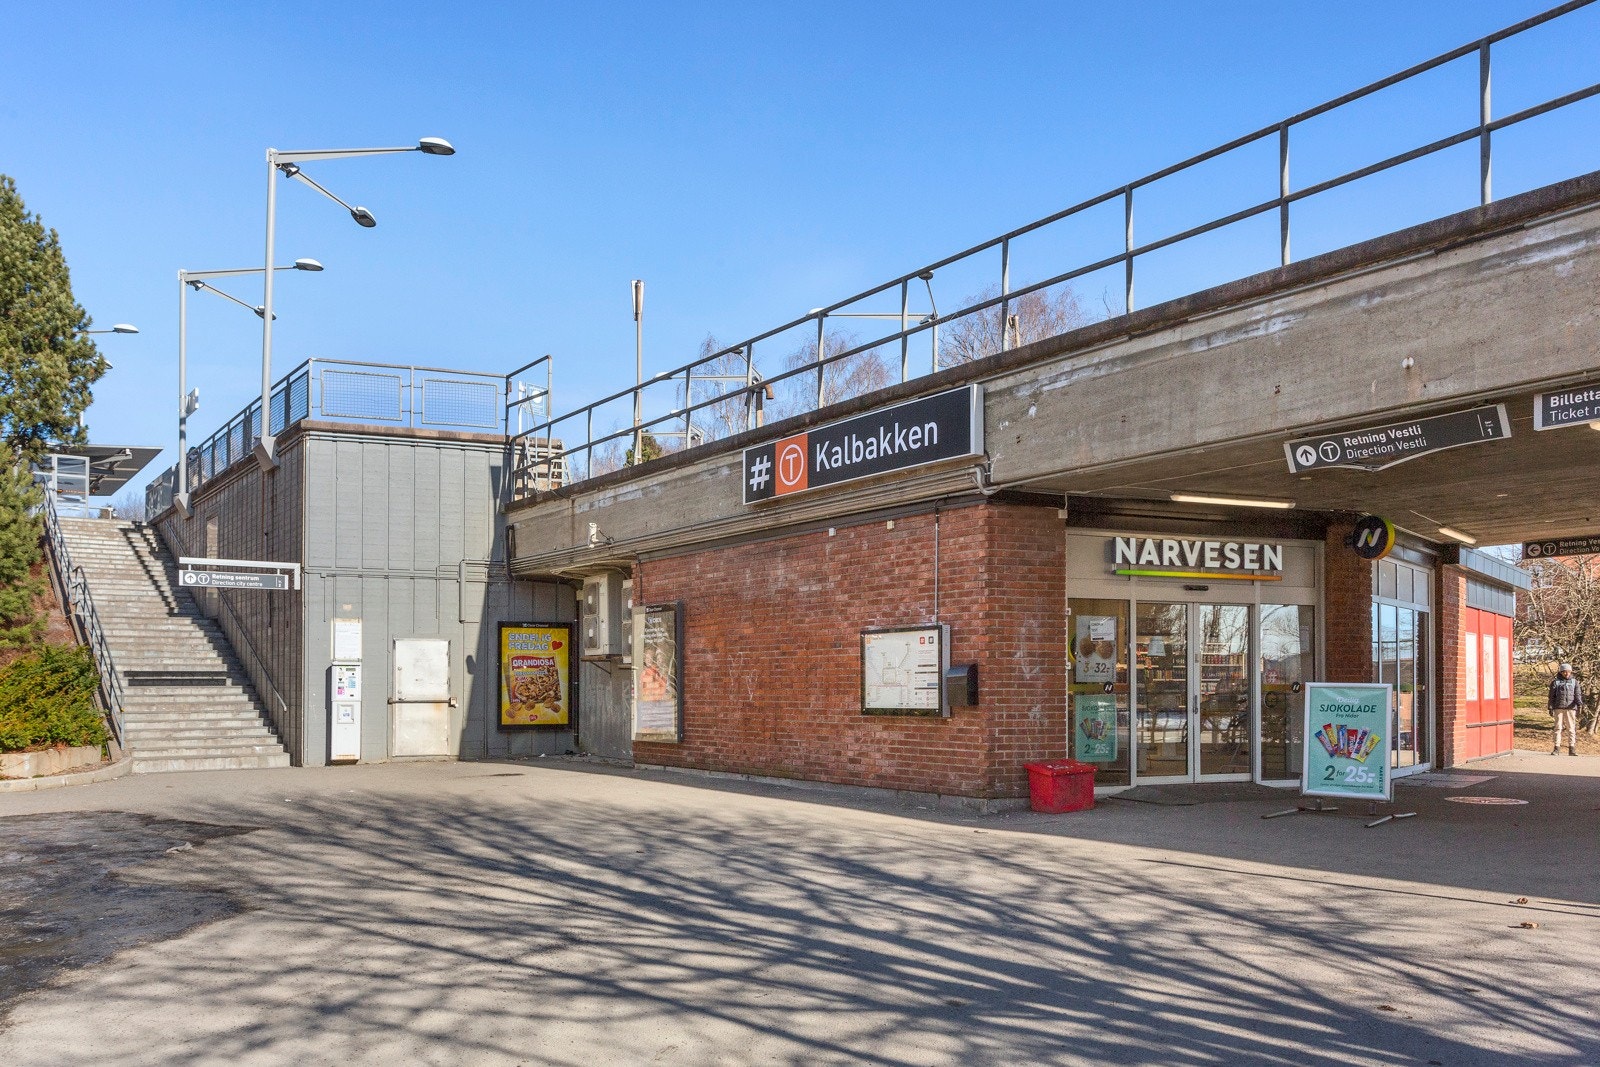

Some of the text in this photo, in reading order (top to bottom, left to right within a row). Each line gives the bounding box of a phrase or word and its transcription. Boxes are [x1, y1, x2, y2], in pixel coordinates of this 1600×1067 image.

[1549, 406, 1590, 422] Ticket
[1343, 430, 1387, 448] Retning
[1387, 424, 1422, 440] Vestli
[1487, 428, 1493, 436] 1
[816, 421, 938, 472] Kalbakken
[1346, 436, 1428, 460] Direction Vestli
[1559, 539, 1587, 548] Retning
[1115, 536, 1283, 571] NARVESEN
[1559, 547, 1590, 555] Direction
[211, 573, 234, 581] Retning
[508, 632, 552, 642] ENDELIG
[508, 641, 549, 651] FREDAG
[512, 659, 555, 667] GRANDIOSA
[1319, 704, 1377, 713] SJOKOLADE
[1323, 764, 1336, 781] 2
[1336, 769, 1345, 777] for
